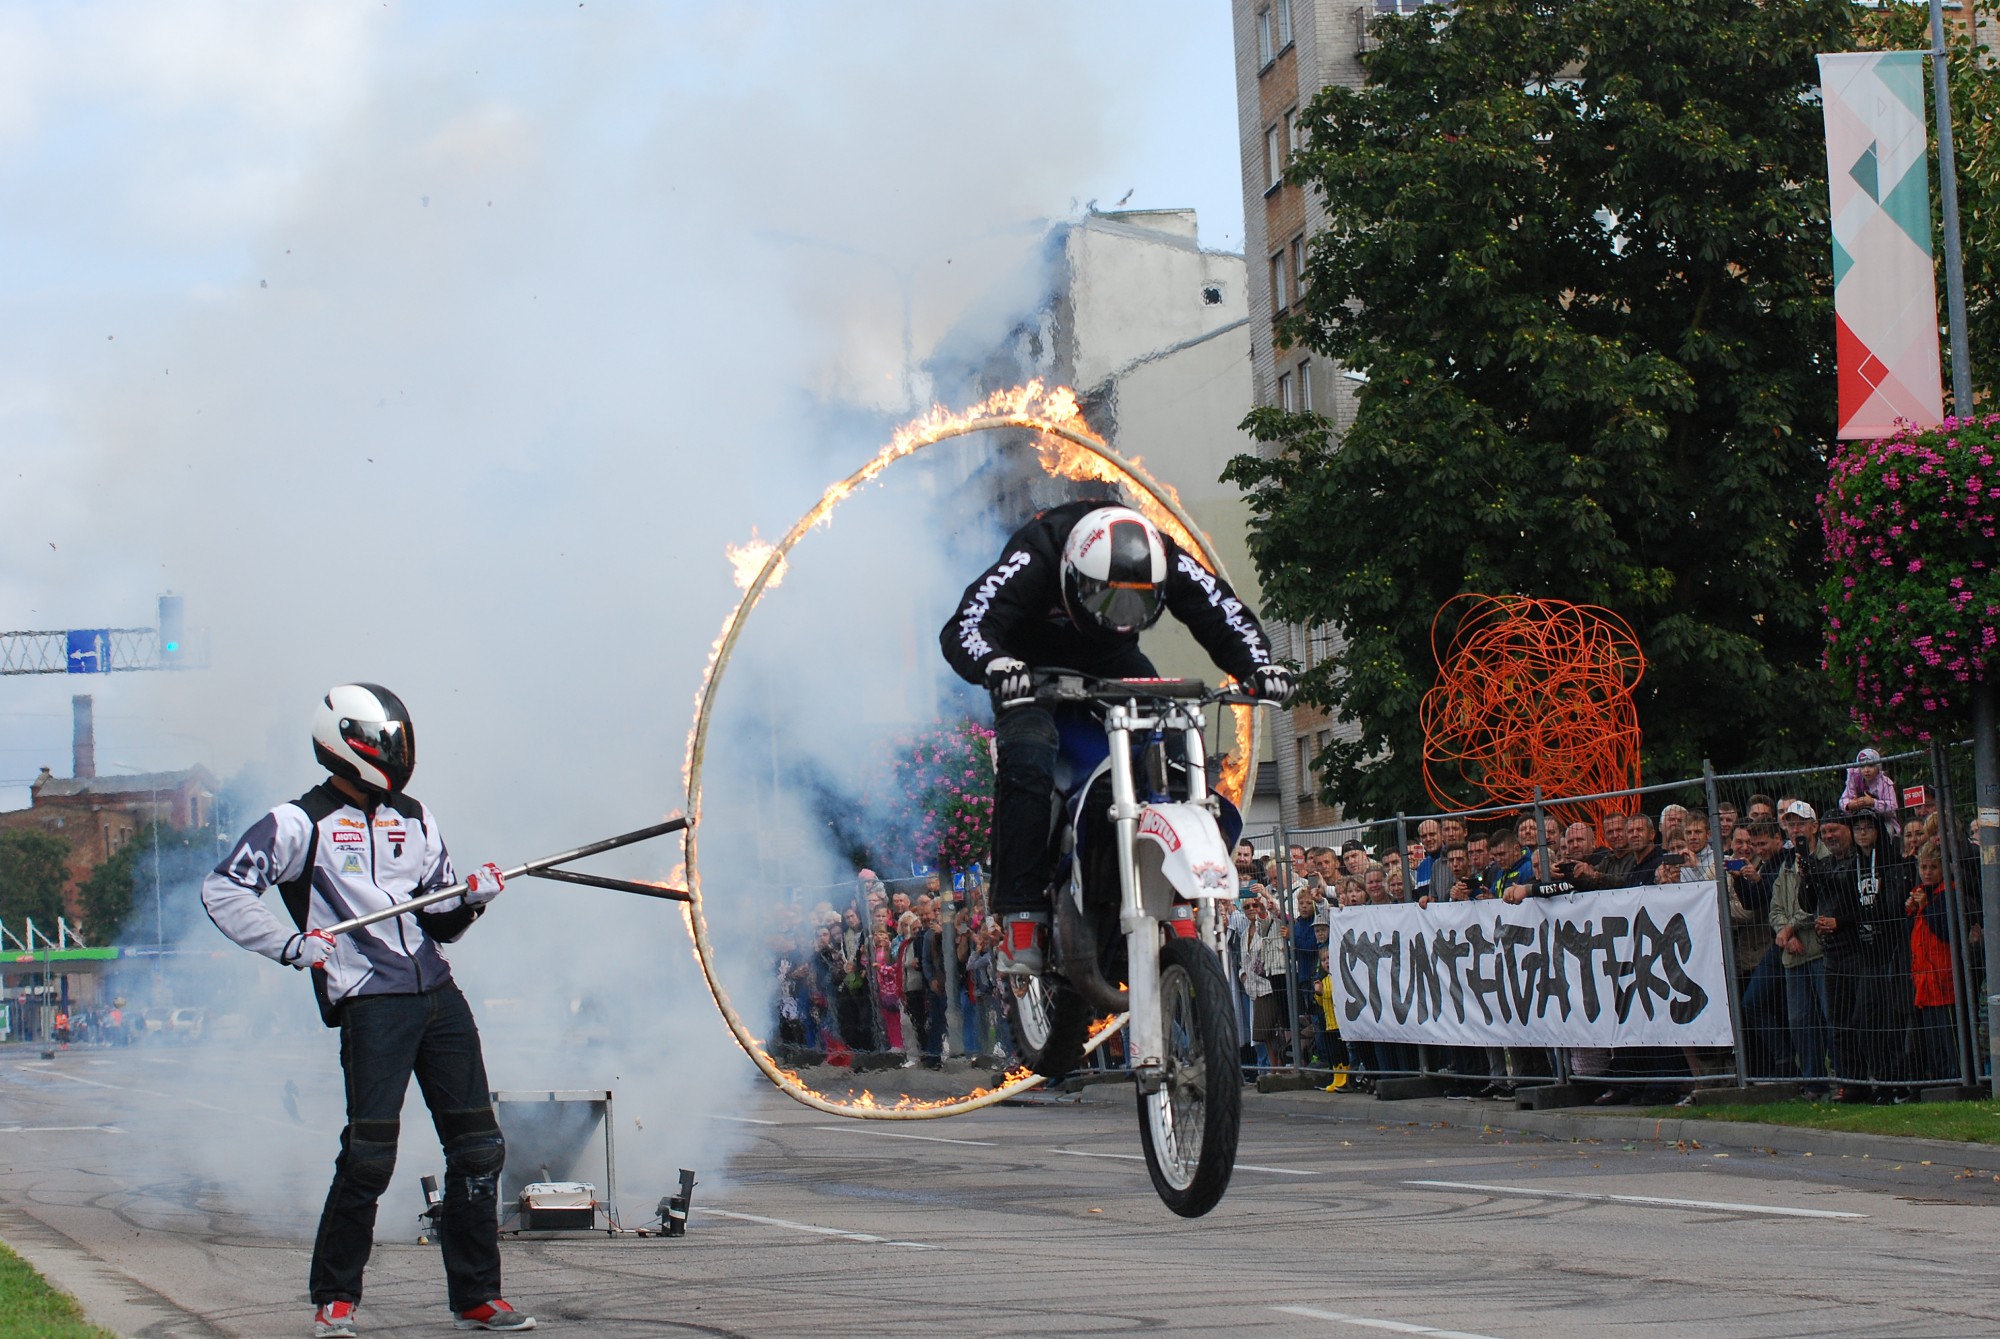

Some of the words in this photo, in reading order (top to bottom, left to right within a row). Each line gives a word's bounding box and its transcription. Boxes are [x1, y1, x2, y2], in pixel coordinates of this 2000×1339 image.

[335, 832, 362, 842] MOTUL
[1141, 811, 1177, 851] MOTUL
[1539, 883, 1557, 894] WEST
[1338, 905, 1709, 1027] STUNTFIGHTERS
